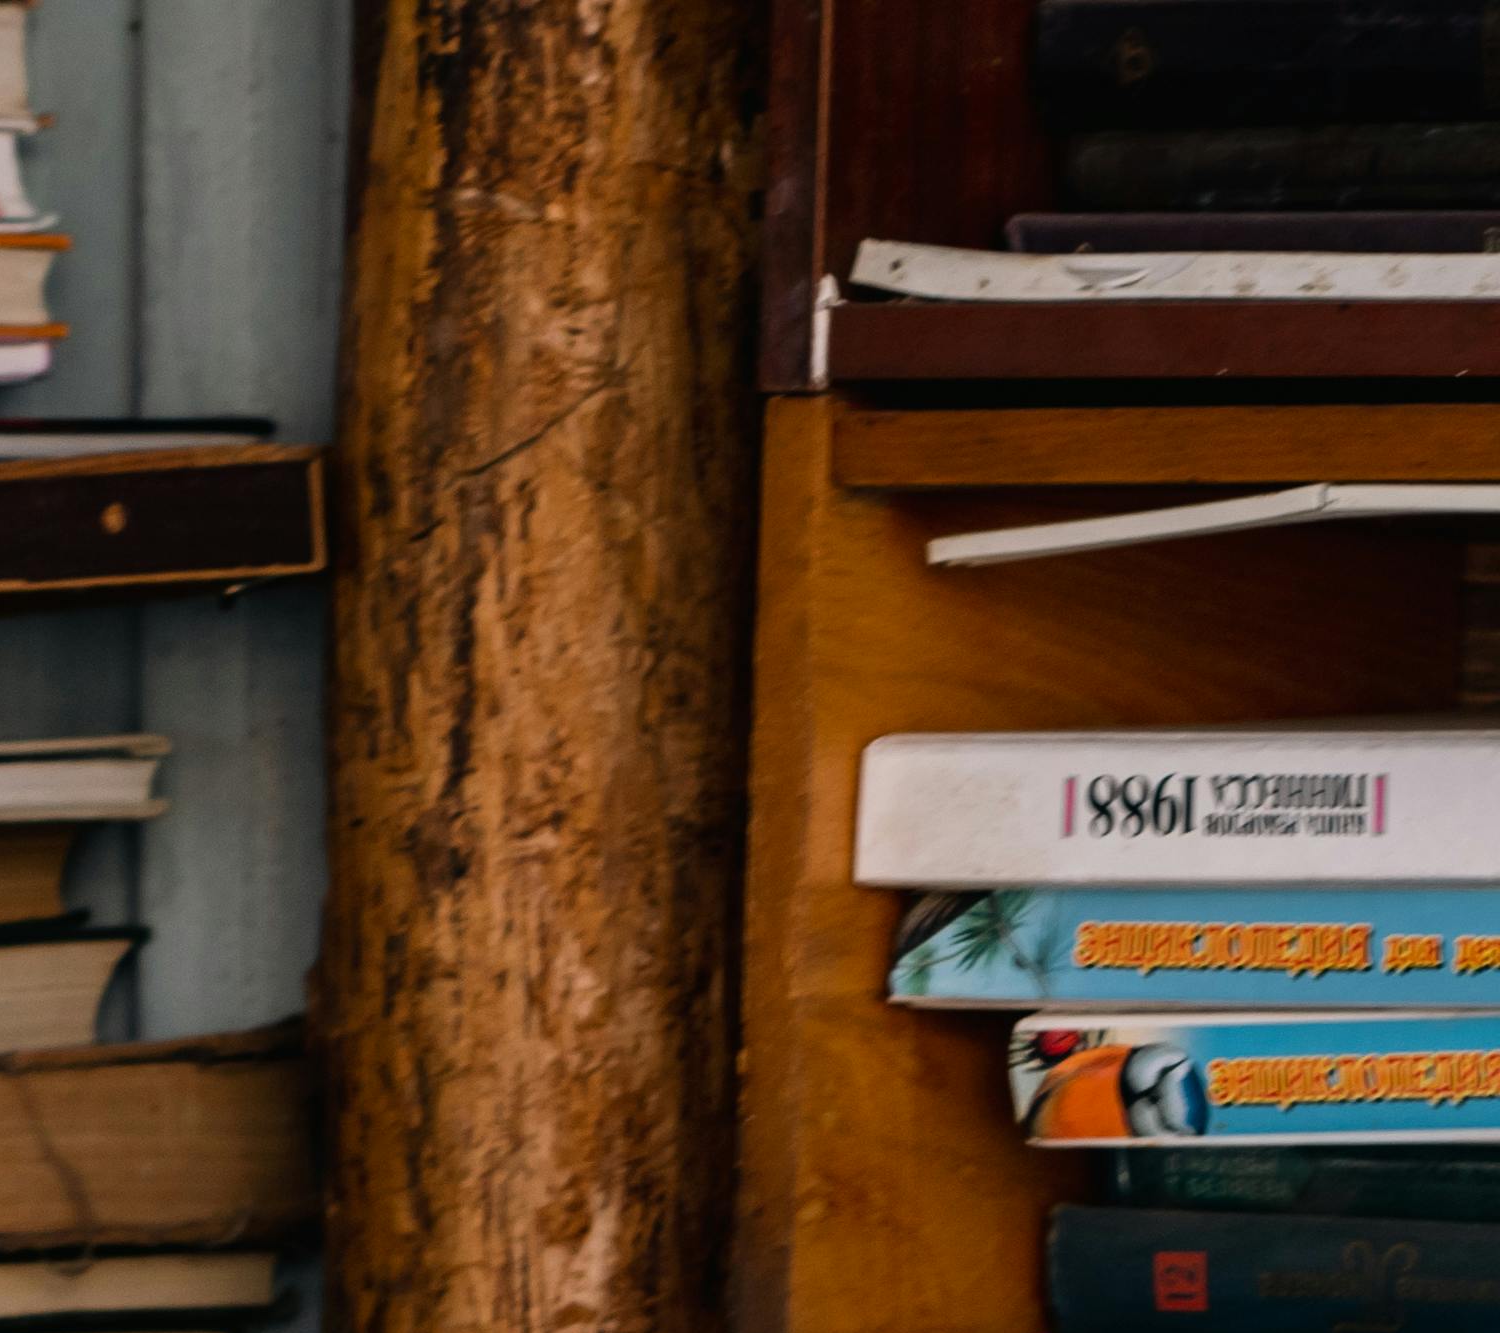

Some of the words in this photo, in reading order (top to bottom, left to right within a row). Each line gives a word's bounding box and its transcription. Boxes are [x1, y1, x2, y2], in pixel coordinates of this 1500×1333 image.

[1086, 772, 1200, 838] 1988
[1210, 773, 1368, 809] ГИННЕССА
[1073, 921, 1374, 977] ЭНЦИКЛОПЕДИЯ
[1381, 933, 1444, 975] для
